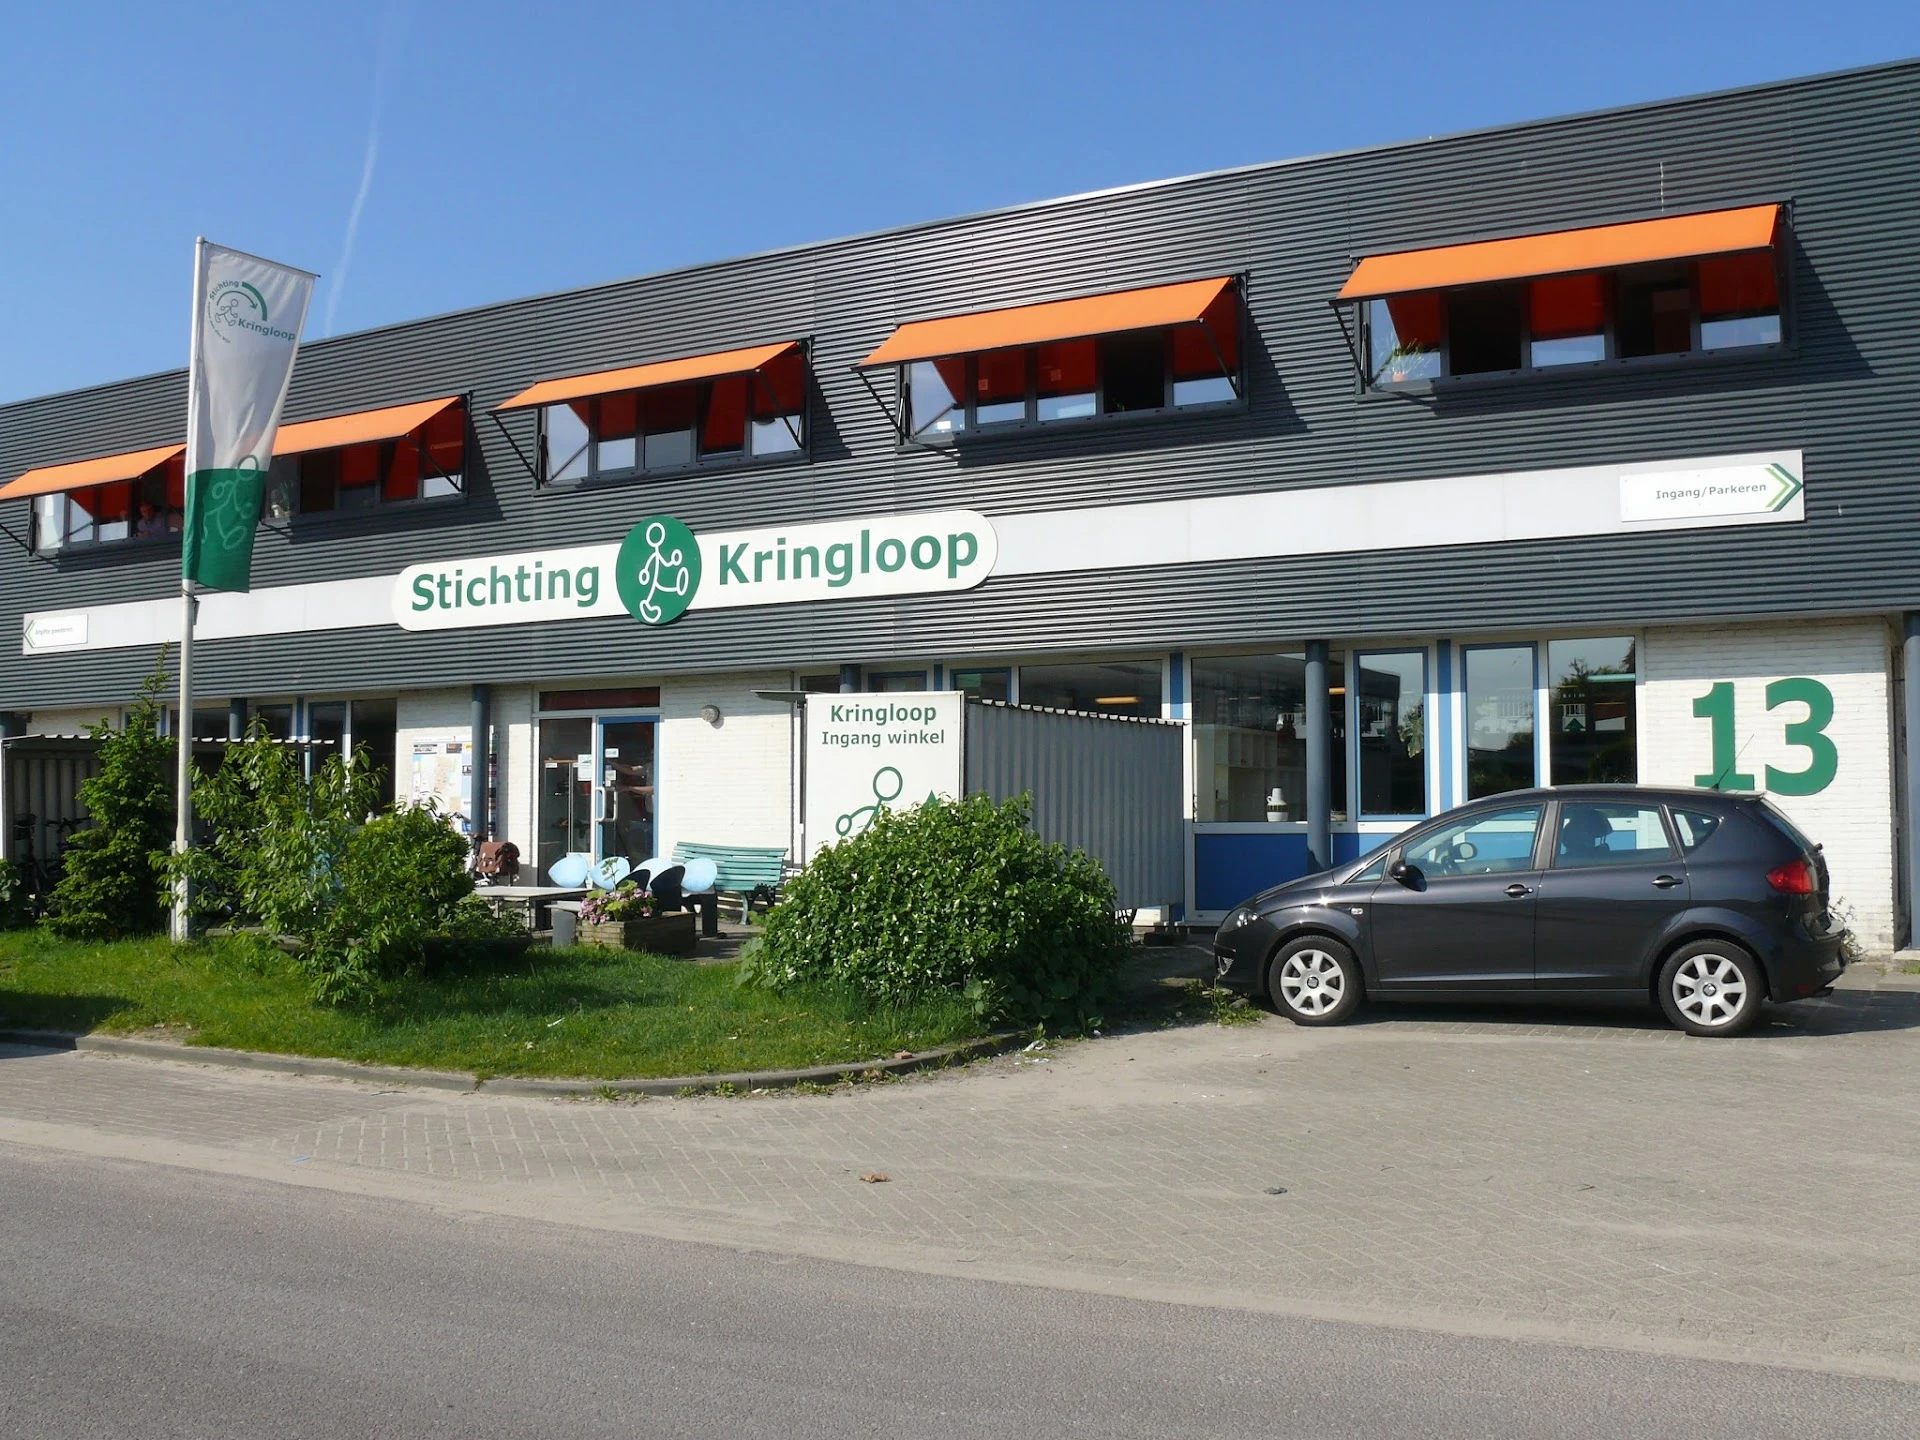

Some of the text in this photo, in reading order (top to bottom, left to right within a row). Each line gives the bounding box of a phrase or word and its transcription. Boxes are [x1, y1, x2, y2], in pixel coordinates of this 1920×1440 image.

[209, 280, 240, 301] Stichting
[238, 317, 296, 342] Kringloop
[1655, 483, 1767, 501] Ingang/Parkeren
[410, 528, 979, 612] Stichting Kringloop
[830, 703, 937, 726] Kringloop
[821, 729, 945, 748] Ingang winkel
[1692, 676, 1839, 797] 13
